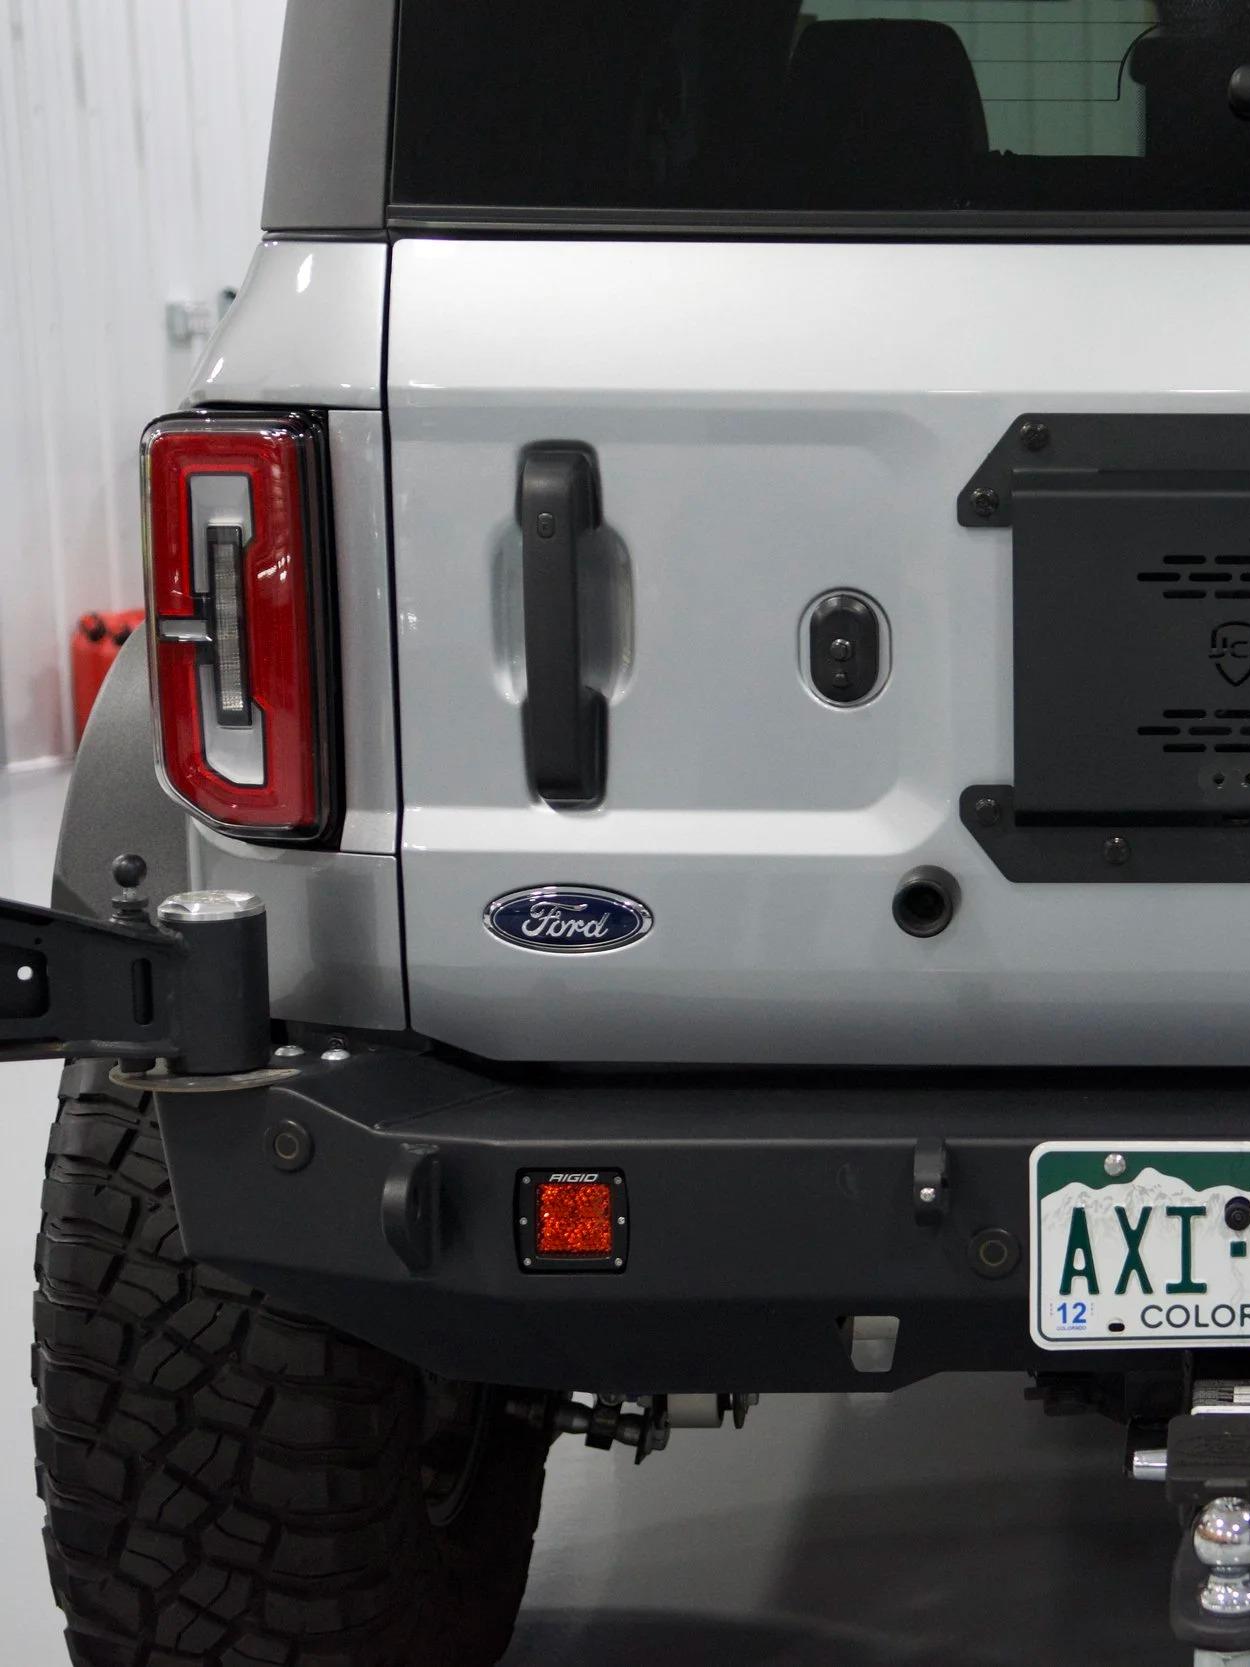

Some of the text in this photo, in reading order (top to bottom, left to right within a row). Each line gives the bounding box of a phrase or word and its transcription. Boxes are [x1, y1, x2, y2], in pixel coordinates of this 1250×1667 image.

[521, 901, 609, 938] Ford
[549, 1173, 599, 1183] RIGID
[1057, 1302, 1087, 1324] 12
